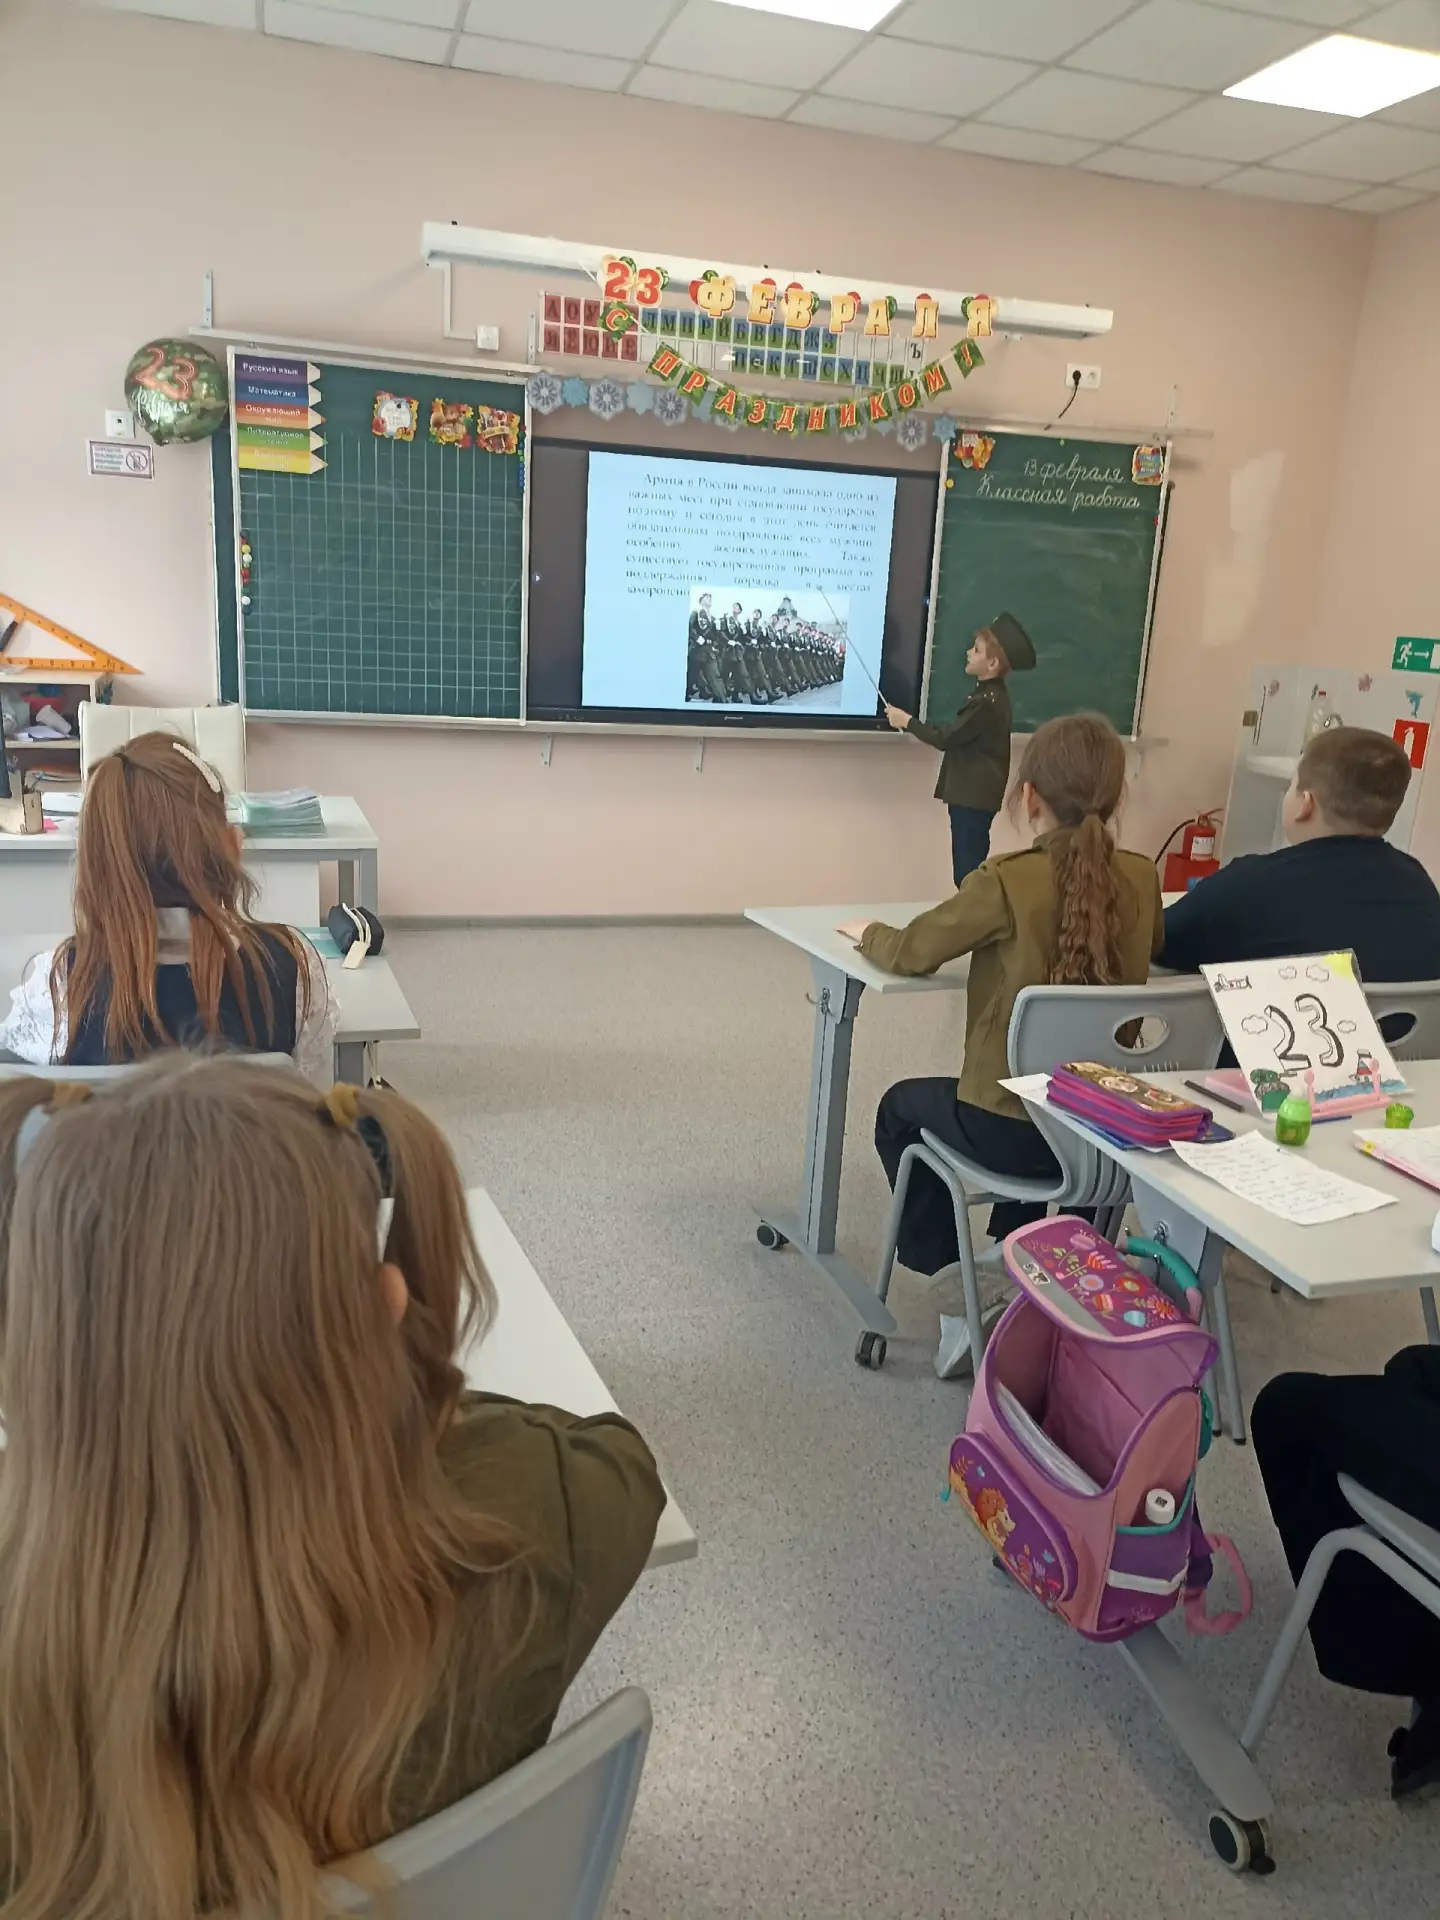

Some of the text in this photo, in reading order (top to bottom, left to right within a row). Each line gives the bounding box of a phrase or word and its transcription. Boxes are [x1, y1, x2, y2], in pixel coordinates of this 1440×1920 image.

[604, 261, 992, 338] 23 ФЕВРАЛЯ
[130, 344, 199, 400] 23
[242, 362, 277, 375] Русский
[606, 308, 974, 431] С ПРАЗДНИКОМ!
[247, 385, 297, 398] Математика
[976, 473, 1067, 504] Классная
[1024, 458, 1037, 477] 13
[1264, 993, 1344, 1071] 23
